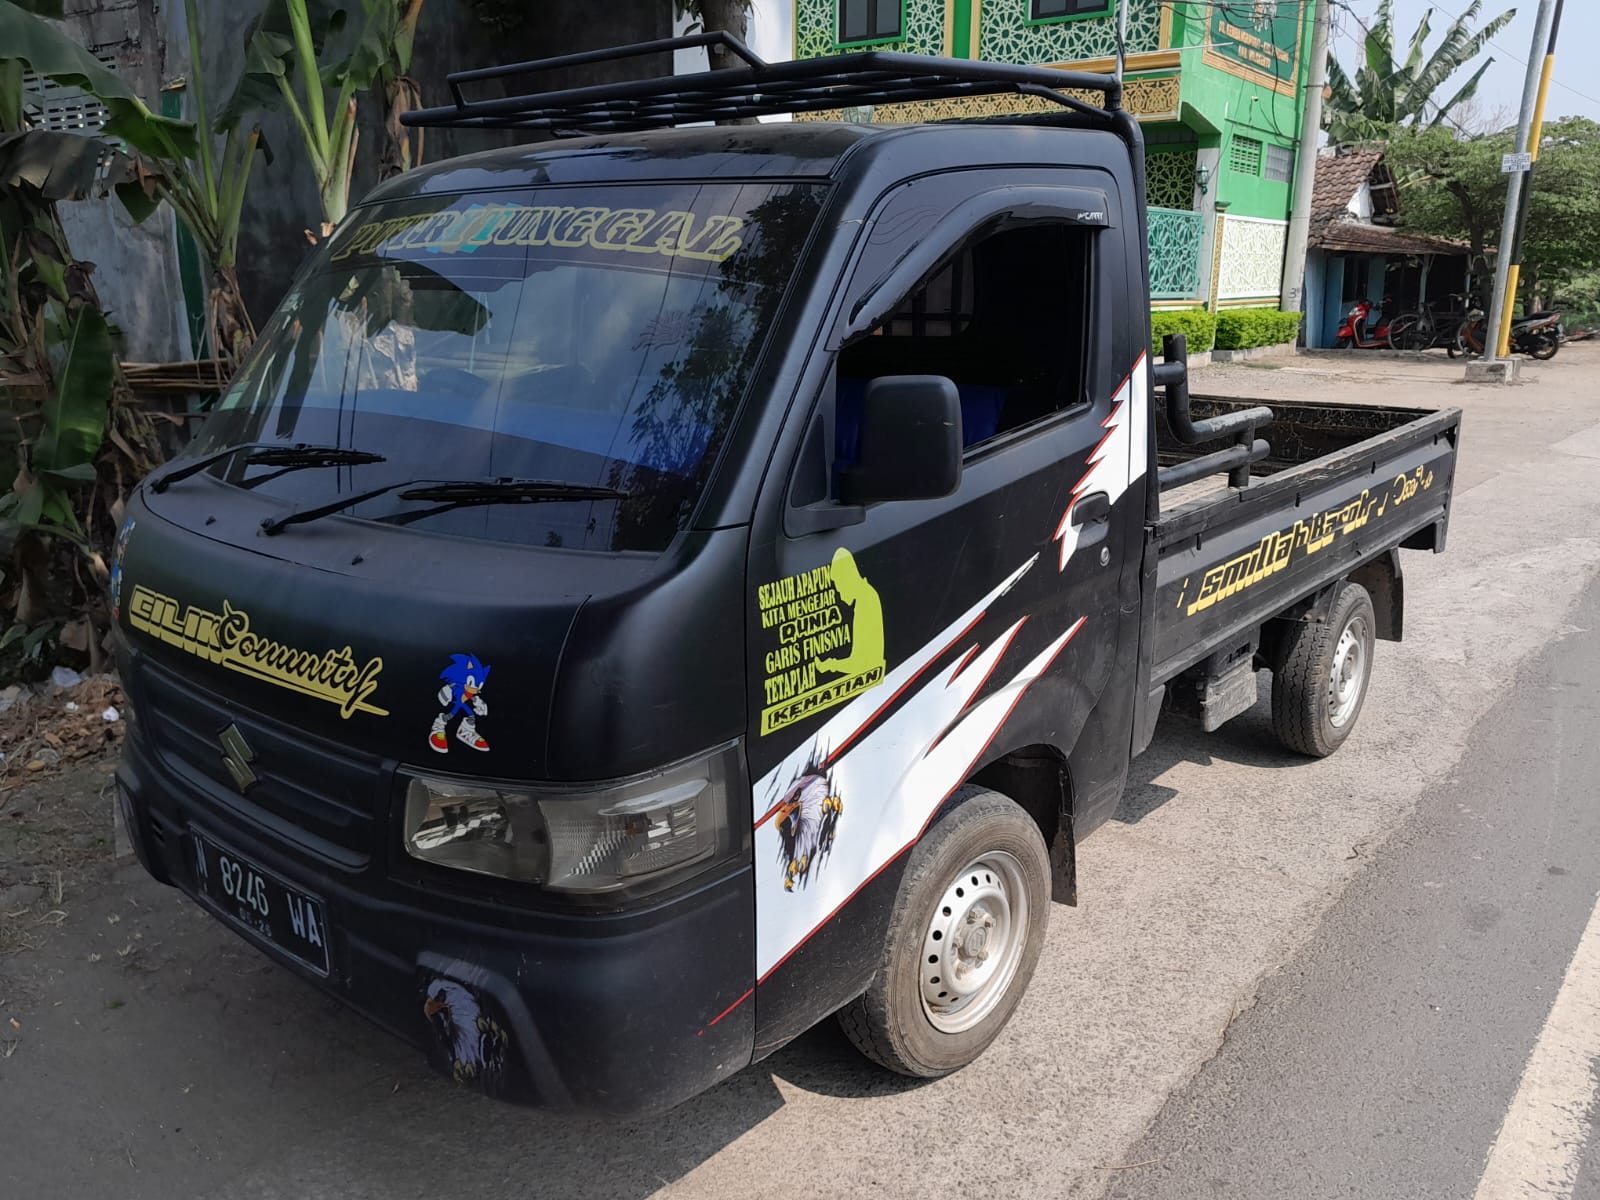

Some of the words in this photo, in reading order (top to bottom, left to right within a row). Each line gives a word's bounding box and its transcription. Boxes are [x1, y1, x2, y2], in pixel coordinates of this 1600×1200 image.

[466, 206, 743, 262] TUNGGAL
[758, 576, 795, 610] SEJAUH
[796, 565, 832, 598] APAPUN
[761, 607, 786, 629] KITA
[787, 589, 836, 620] MENGEJAR
[765, 645, 801, 673] GARIS
[803, 624, 851, 660] FINISNYA
[779, 605, 842, 645] DUNIA
[770, 667, 882, 728] KEMATIAN
[219, 856, 269, 916] 8246
[286, 893, 322, 947] WA
